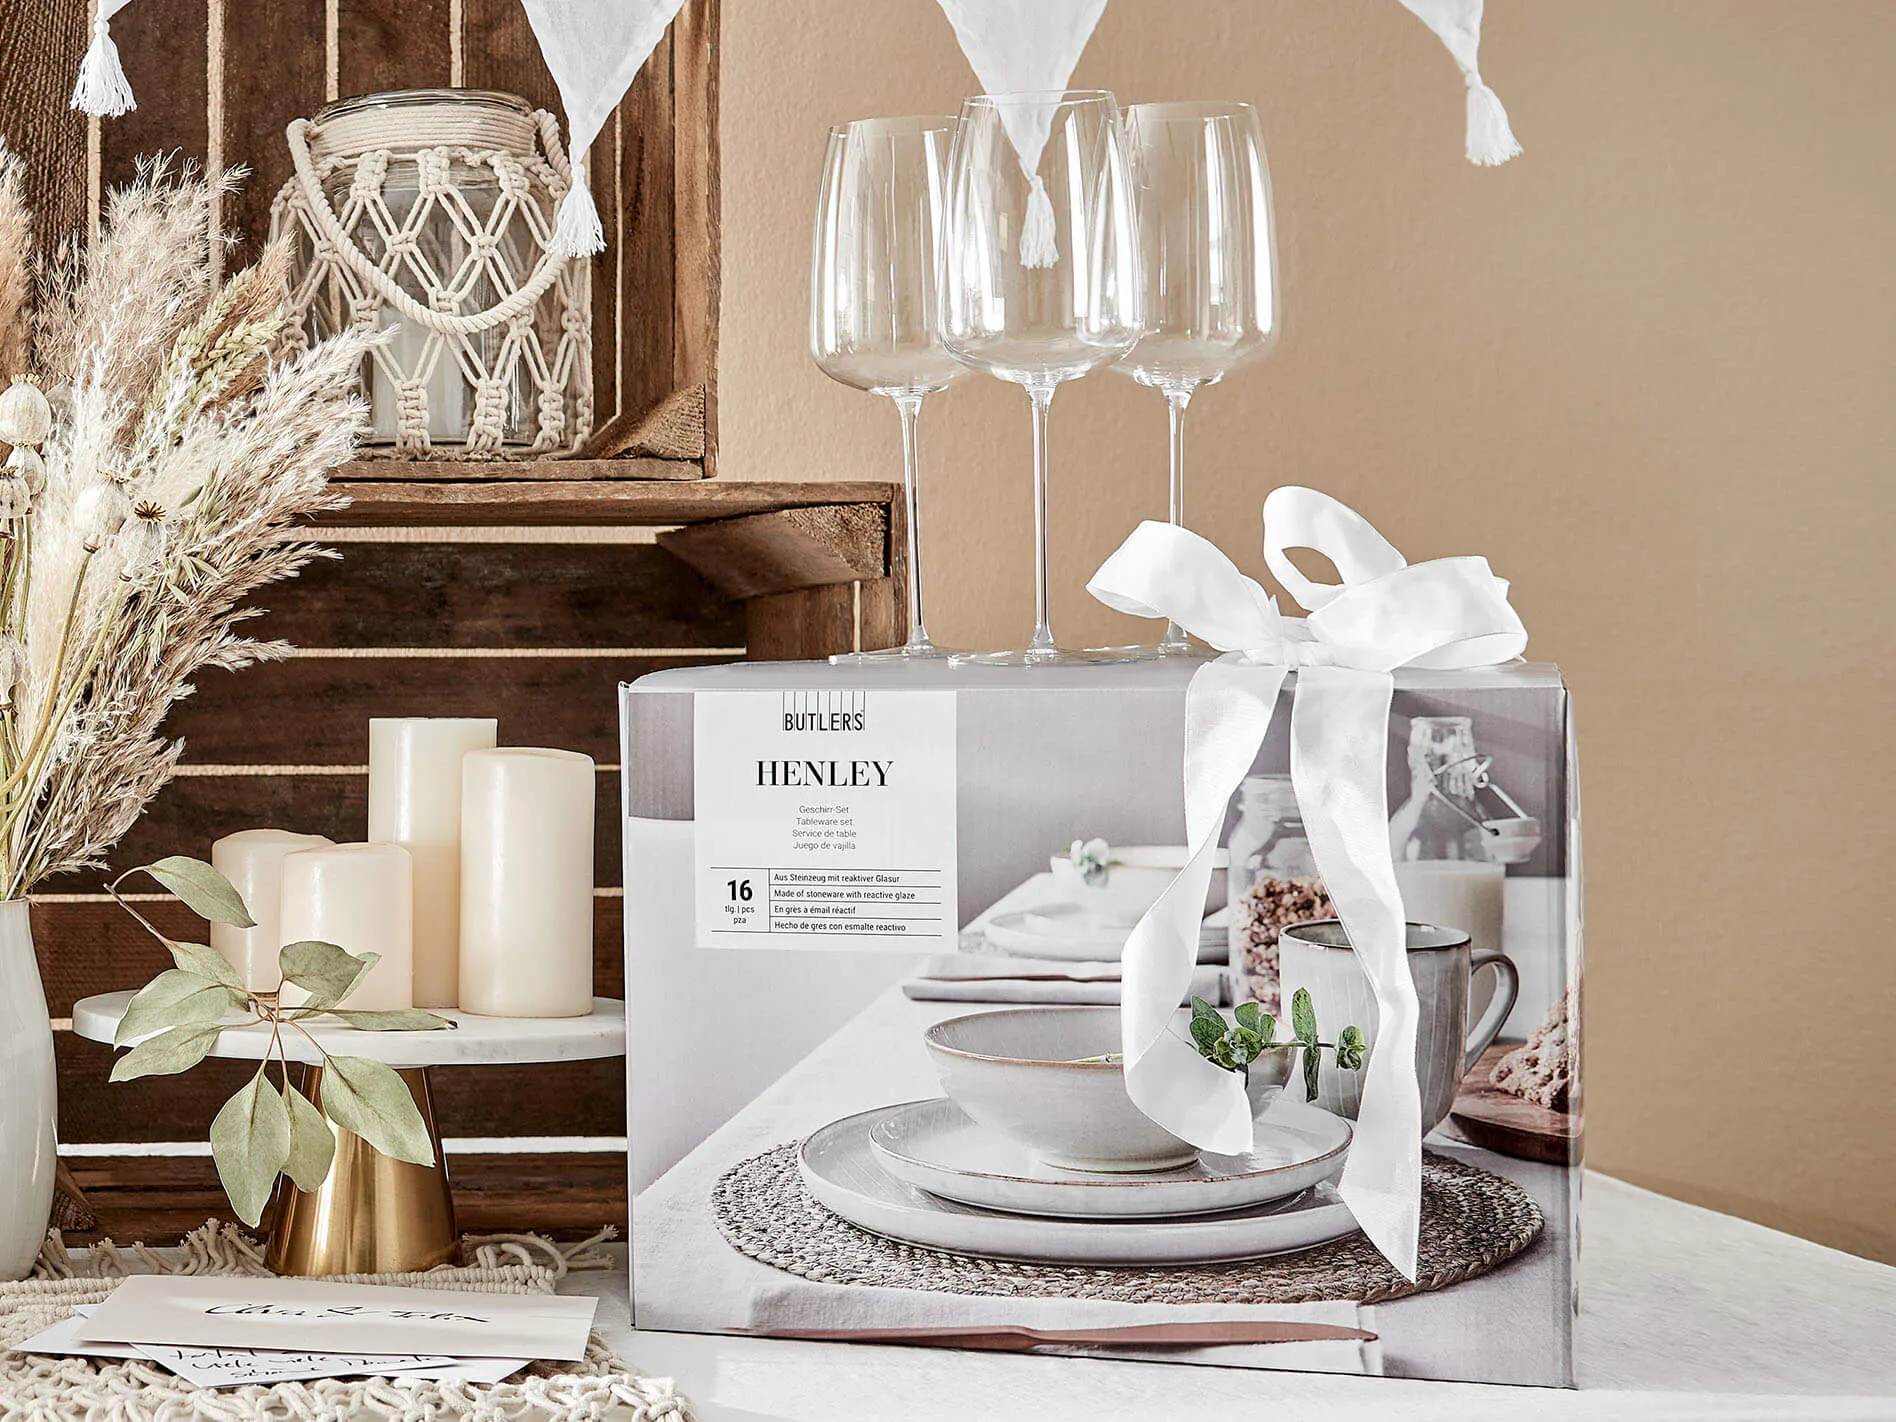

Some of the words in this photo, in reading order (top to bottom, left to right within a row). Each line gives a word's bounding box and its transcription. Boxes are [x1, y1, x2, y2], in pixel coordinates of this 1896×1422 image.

[784, 712, 863, 731] BUTLERS
[756, 760, 894, 787] HENLEY
[799, 805, 849, 814] Geschirr-Set
[796, 817, 838, 826] Tableware
[840, 818, 853, 826] set
[792, 829, 822, 838] Service
[824, 829, 834, 838] de
[836, 829, 857, 838] table
[792, 841, 819, 851] Juego
[821, 841, 831, 850] de
[833, 841, 856, 852] vajilla
[774, 873, 788, 881] Aus
[789, 873, 826, 883] Steinzeug
[827, 874, 840, 882] mit
[841, 874, 874, 883] reaktiver
[875, 874, 900, 883] Glasur
[727, 879, 753, 901] 16
[774, 889, 795, 898] Made
[796, 889, 805, 898] of
[806, 890, 844, 899] stoneware
[845, 890, 862, 899] with
[863, 890, 893, 900] reactive
[894, 891, 916, 902] glaze
[741, 906, 755, 915] pcs
[774, 905, 784, 913] En
[774, 921, 799, 930] Hecho
[799, 921, 810, 930] de
[828, 923, 843, 931] con
[844, 922, 874, 931] esmalte
[875, 922, 906, 932] reactivo
